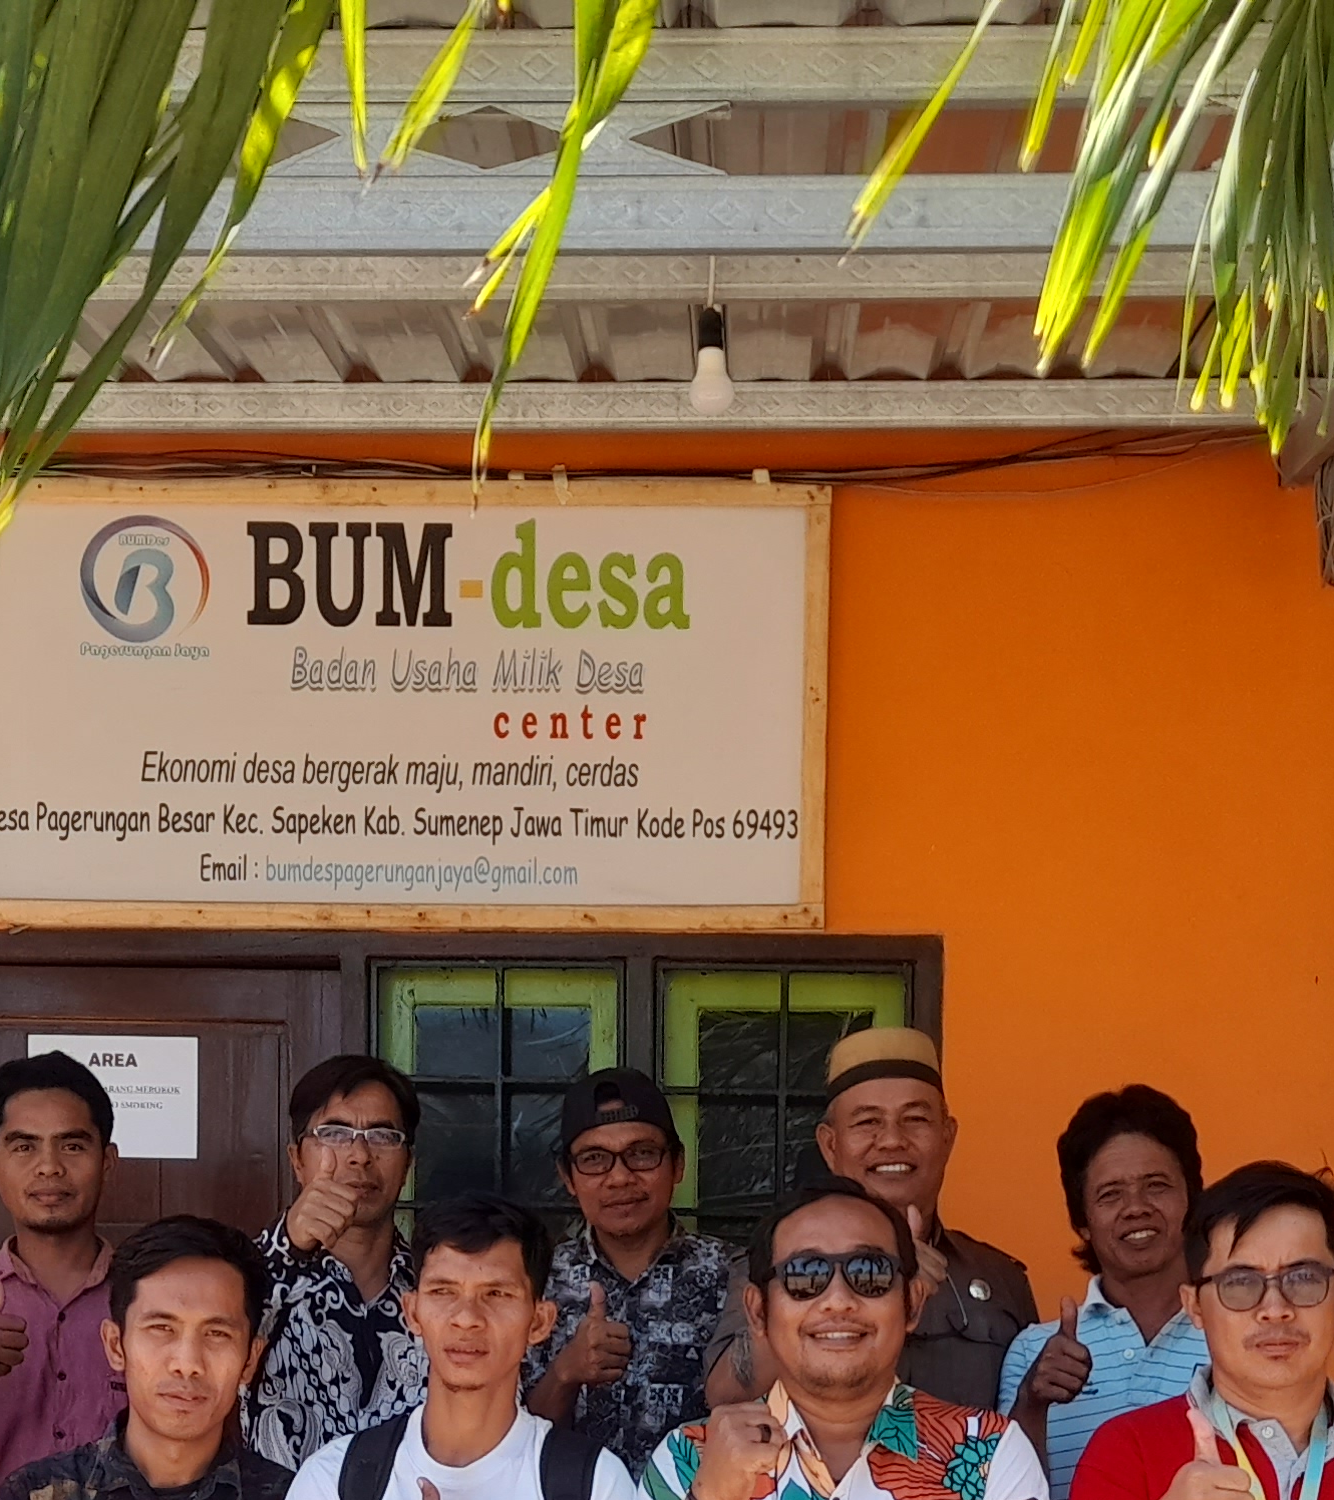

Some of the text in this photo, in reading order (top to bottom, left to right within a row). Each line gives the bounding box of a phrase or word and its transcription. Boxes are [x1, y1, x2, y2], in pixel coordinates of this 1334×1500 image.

[80, 642, 210, 660] Pagerungan Jaya
[289, 646, 646, 694] Badan Usaha Milik Desa
[492, 704, 648, 740] center
[141, 750, 639, 793] Ekonomi desa bergerak maju, mandiri, cerdas
[36, 801, 150, 842] Pagerungan
[158, 802, 215, 833] Besar
[223, 803, 264, 835] Kec.
[271, 804, 356, 844] Sapeken
[364, 805, 405, 836] Kab.
[413, 806, 503, 845] Sumenep
[510, 806, 562, 838] Jawa
[570, 807, 628, 838] Timur
[637, 806, 685, 839] Kode
[692, 808, 725, 839] Pos
[732, 808, 799, 840] 69493
[200, 853, 247, 884] Email
[266, 855, 579, 891] bumdespagerunganjaya@gmail.com
[88, 1052, 138, 1068] AREA
[104, 1085, 133, 1094] ARANG
